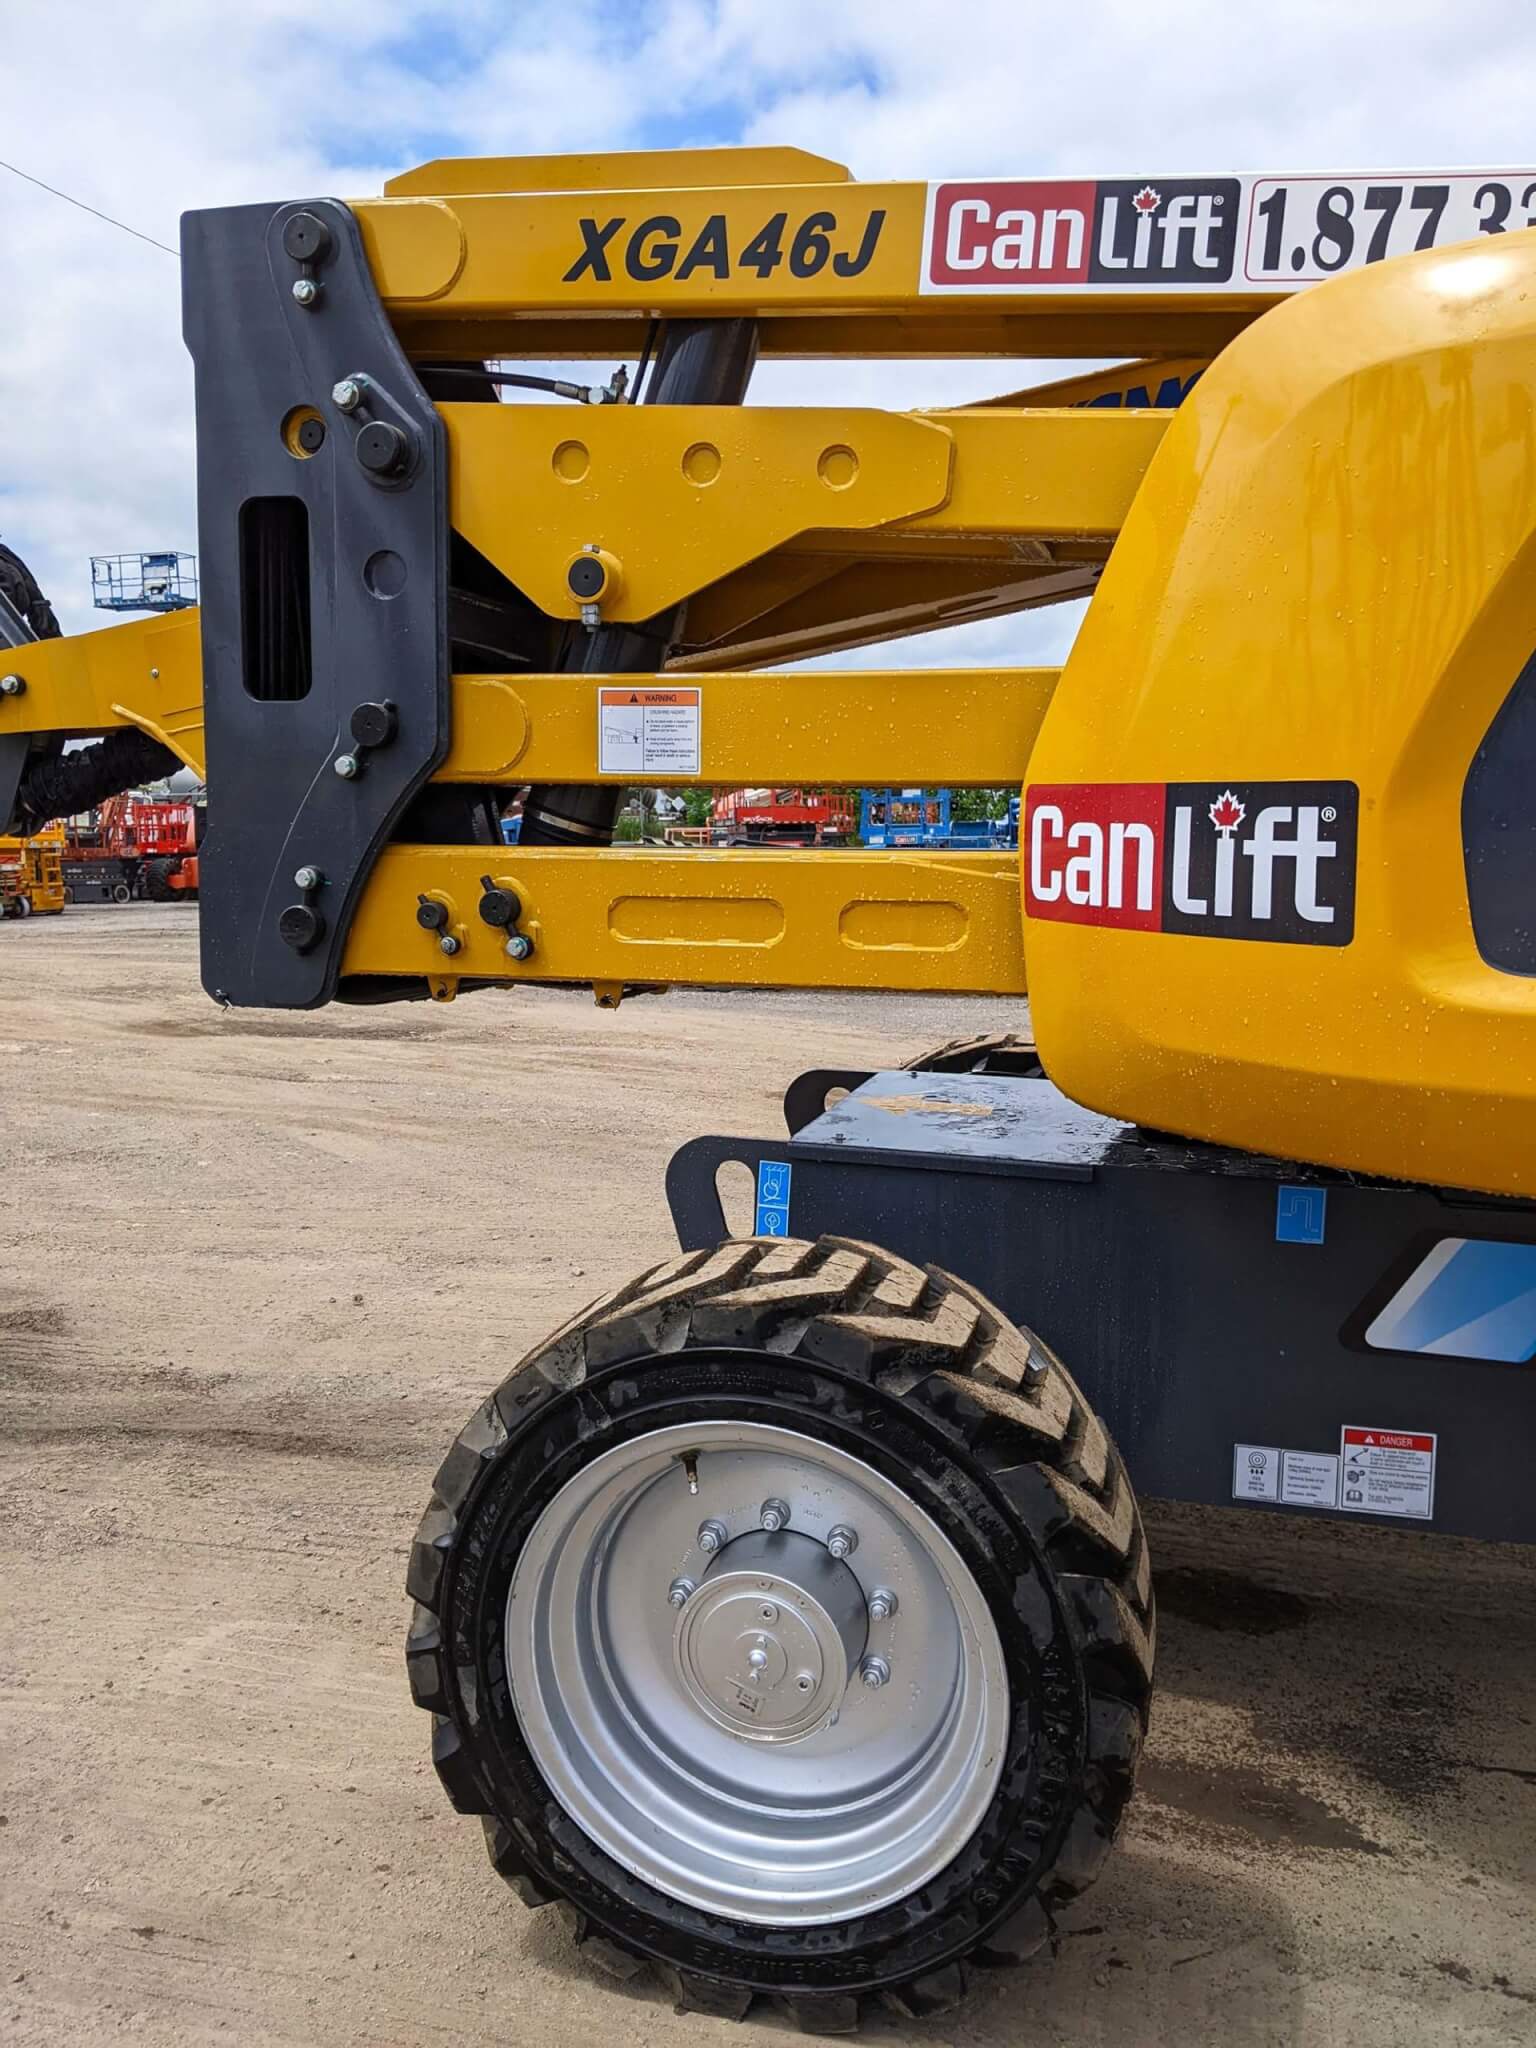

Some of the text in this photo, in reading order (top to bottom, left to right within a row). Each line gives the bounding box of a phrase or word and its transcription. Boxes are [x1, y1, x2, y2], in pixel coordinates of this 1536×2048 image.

[562, 210, 887, 282] XGA46J
[644, 694, 677, 702] WARNING
[1379, 1435, 1413, 1448] DANGER
